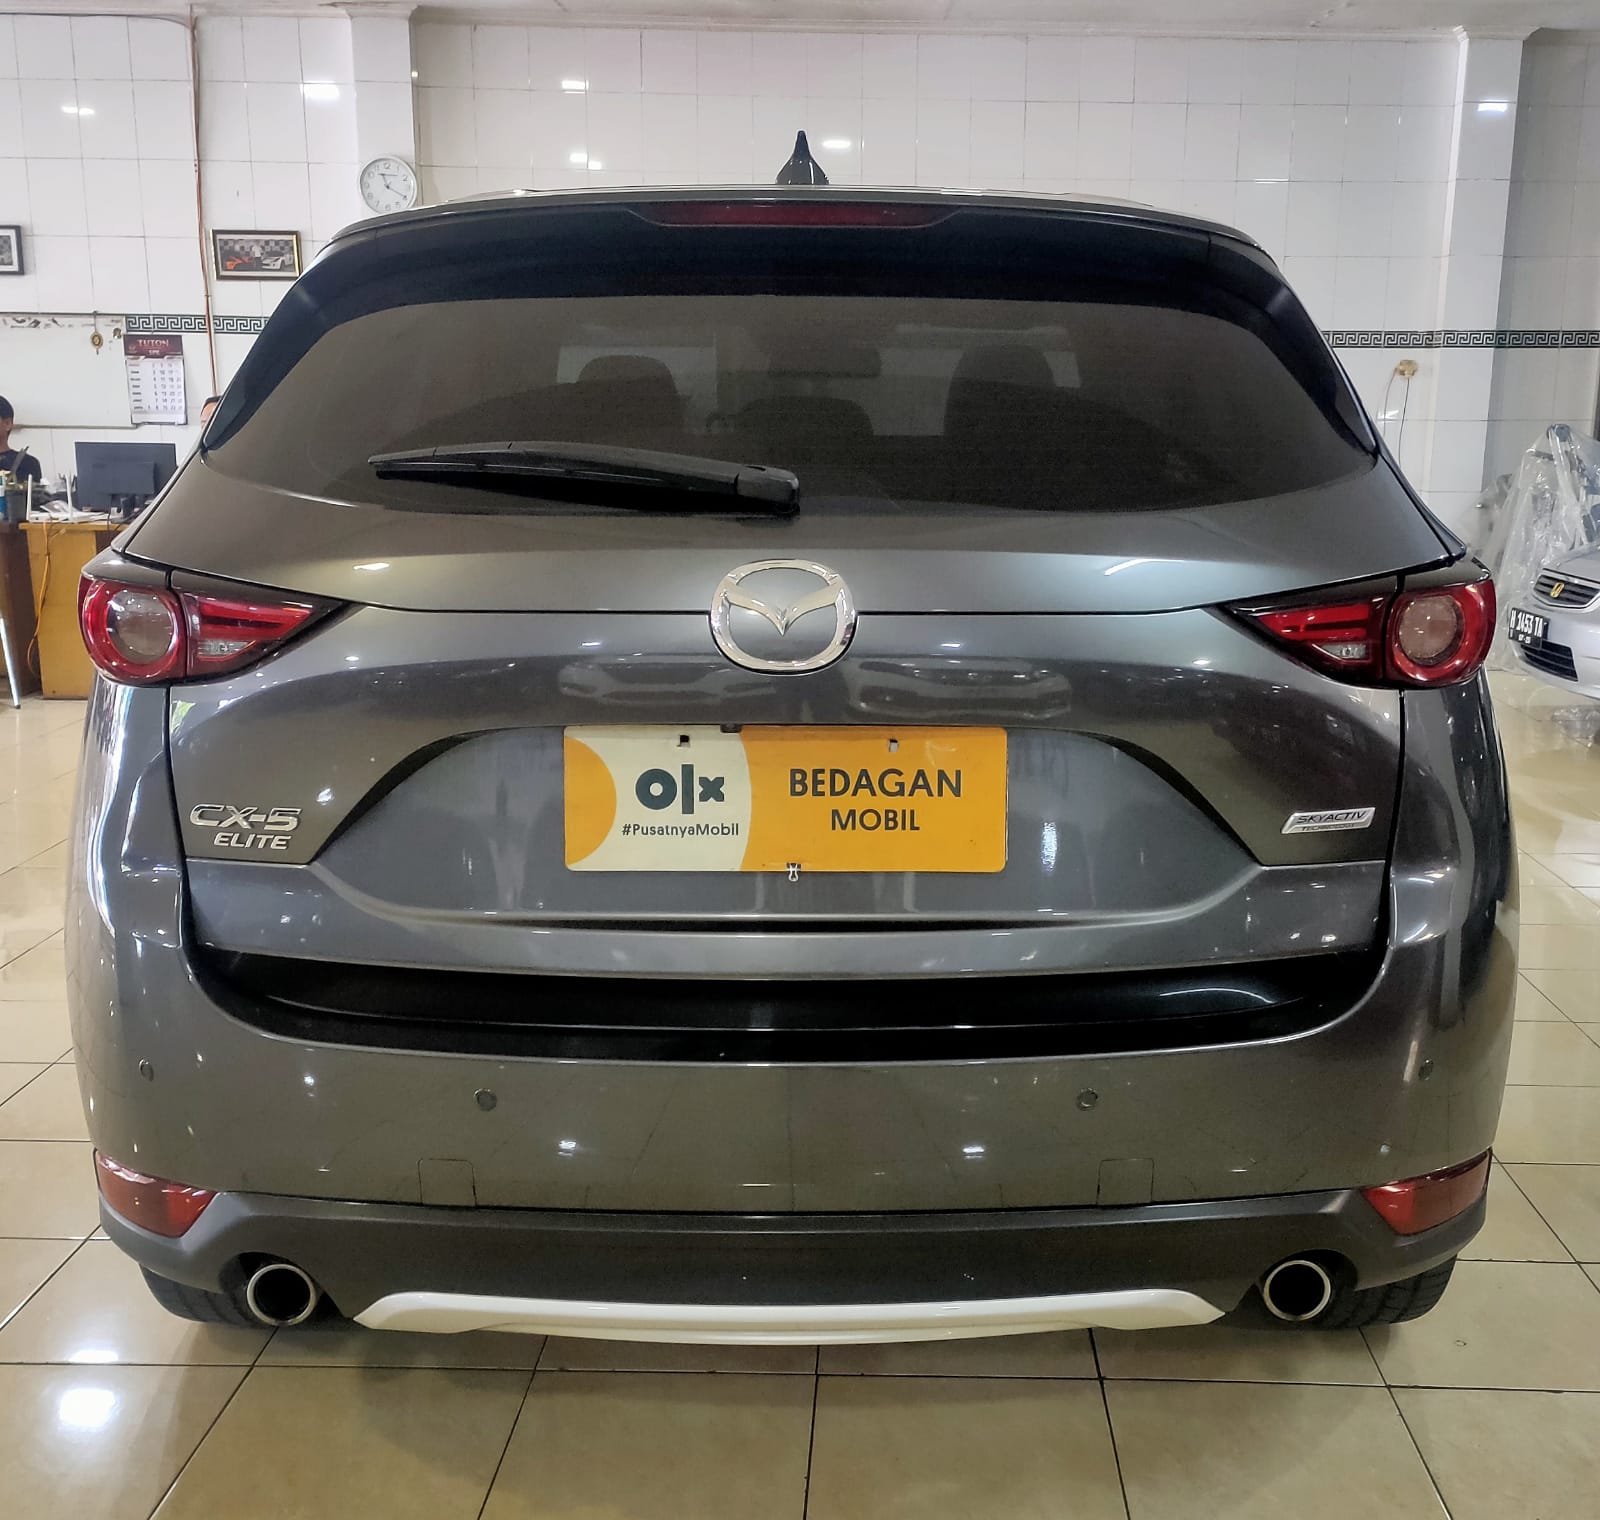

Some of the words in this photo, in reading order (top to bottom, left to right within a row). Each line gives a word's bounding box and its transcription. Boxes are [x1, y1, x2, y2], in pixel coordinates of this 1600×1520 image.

[635, 764, 725, 814] olx
[790, 768, 962, 798] BEDAGAN
[189, 803, 302, 832] CX-5
[831, 809, 920, 831] MOBIL
[1296, 811, 1367, 824] SKYACTIV
[213, 832, 292, 850] ELITE
[621, 823, 740, 838] #PusatnyaMobil
